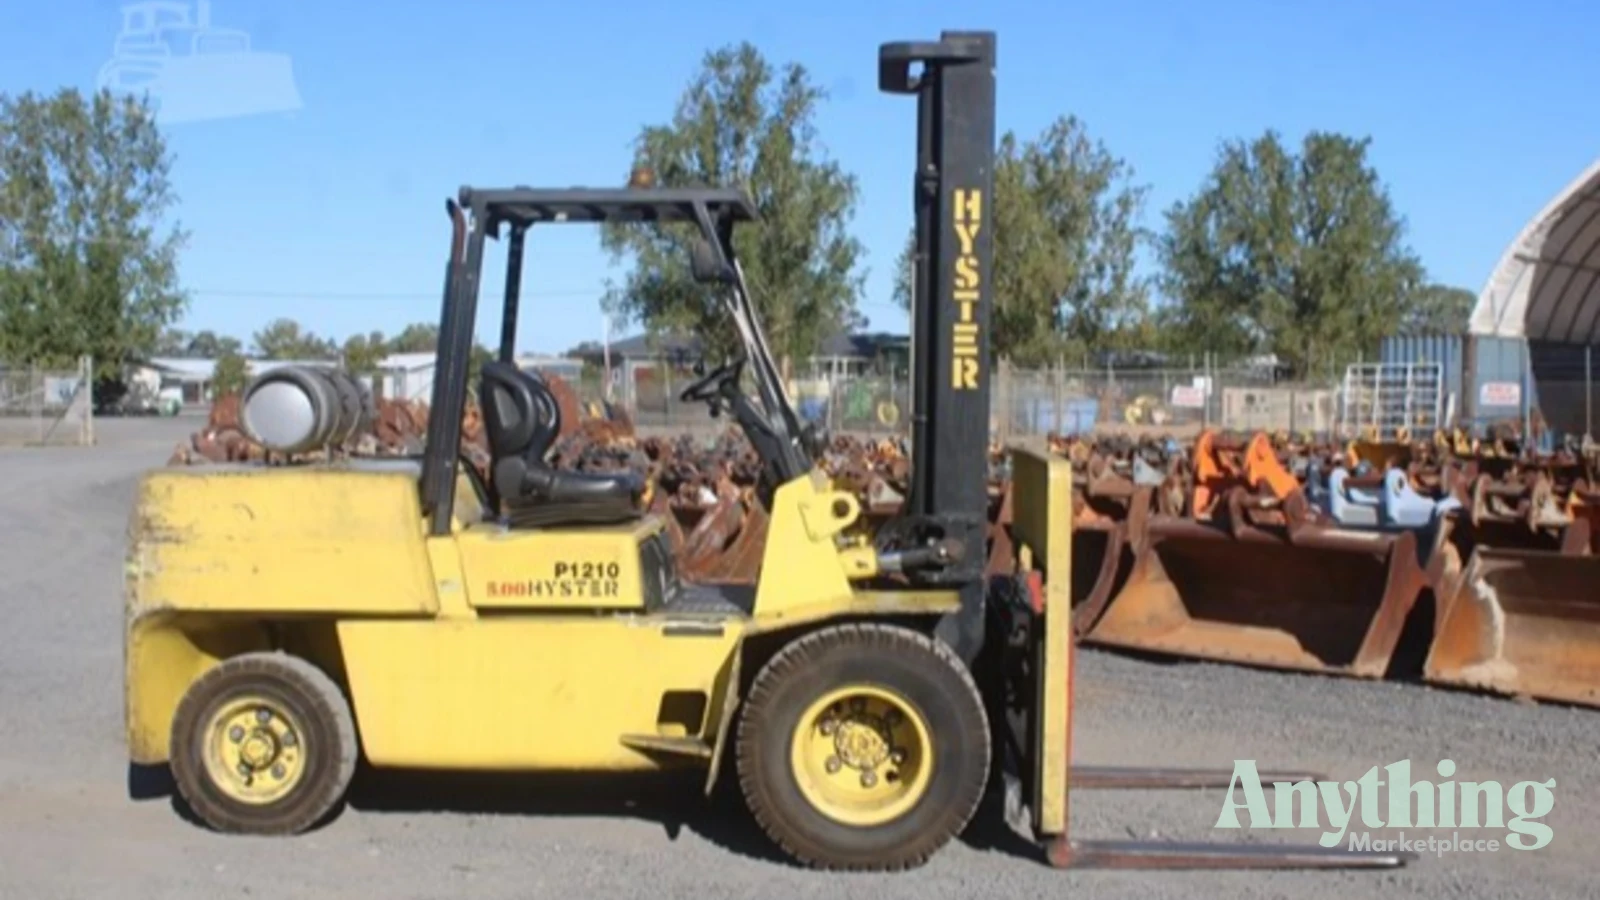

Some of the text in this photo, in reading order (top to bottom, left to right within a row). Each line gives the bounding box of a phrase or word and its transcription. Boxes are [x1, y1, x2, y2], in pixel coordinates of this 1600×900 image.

[953, 189, 981, 389] HYSTER
[554, 562, 620, 578] P1210
[528, 580, 619, 597] HYSTER
